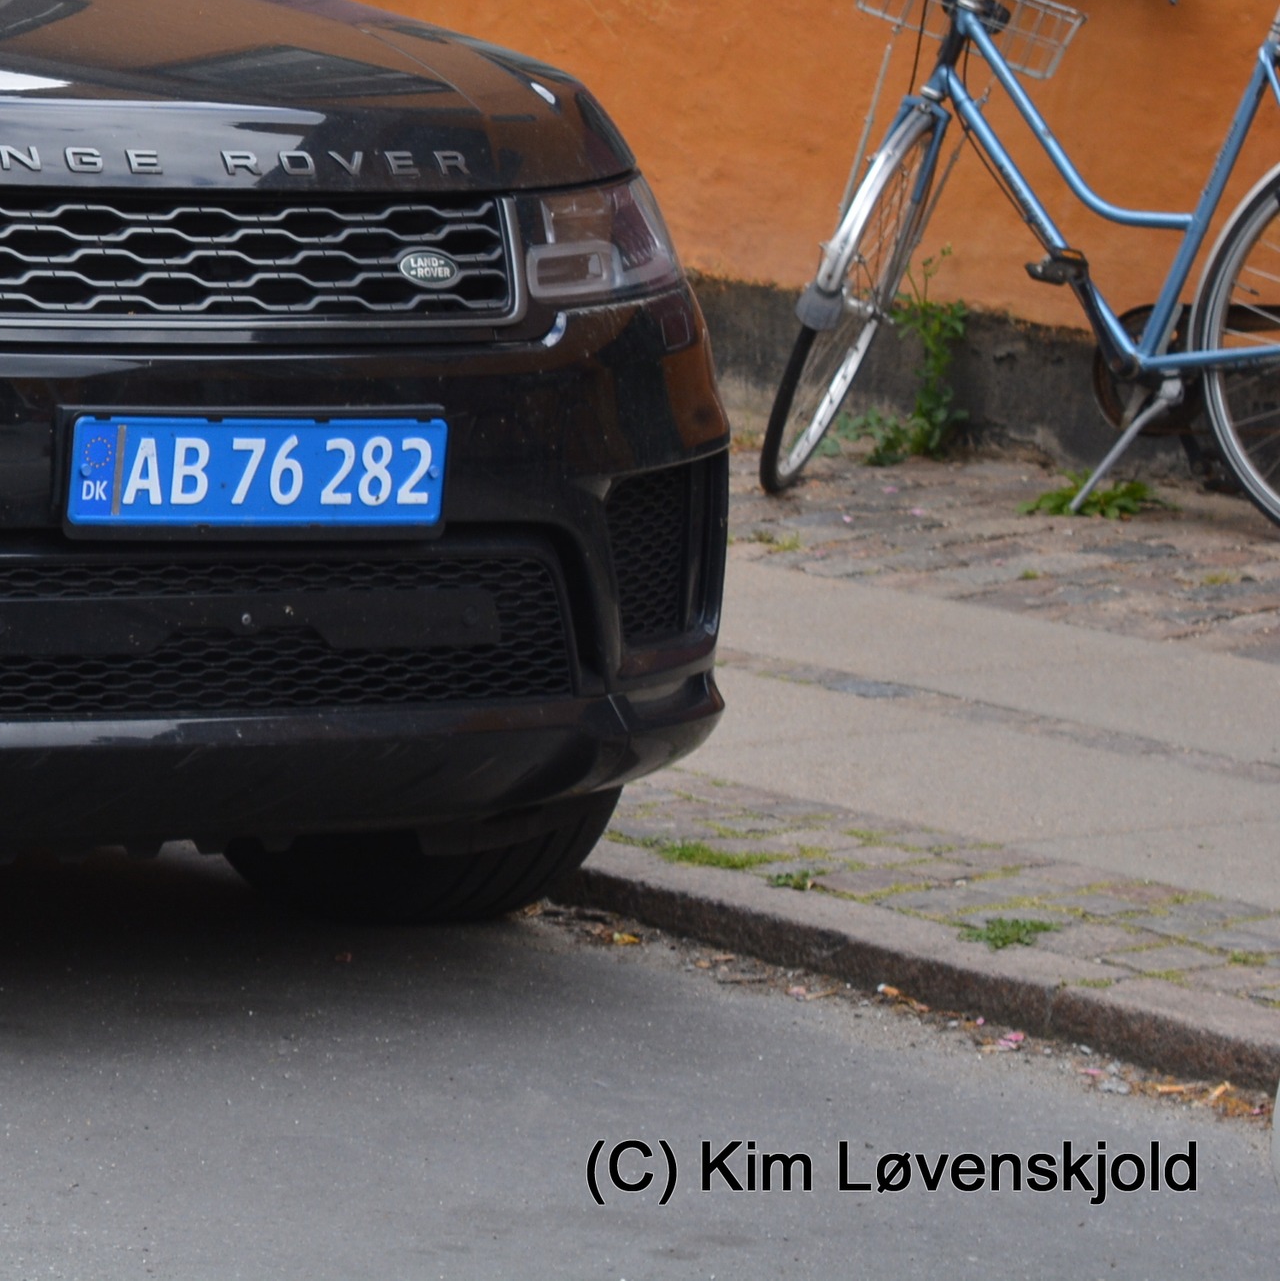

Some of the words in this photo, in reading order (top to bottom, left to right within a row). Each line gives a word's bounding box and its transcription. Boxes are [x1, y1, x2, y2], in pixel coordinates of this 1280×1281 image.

[221, 150, 470, 178] ROVER
[123, 438, 210, 505] AB
[231, 435, 303, 506] 76
[320, 437, 432, 505] 282
[81, 481, 108, 501] DK
